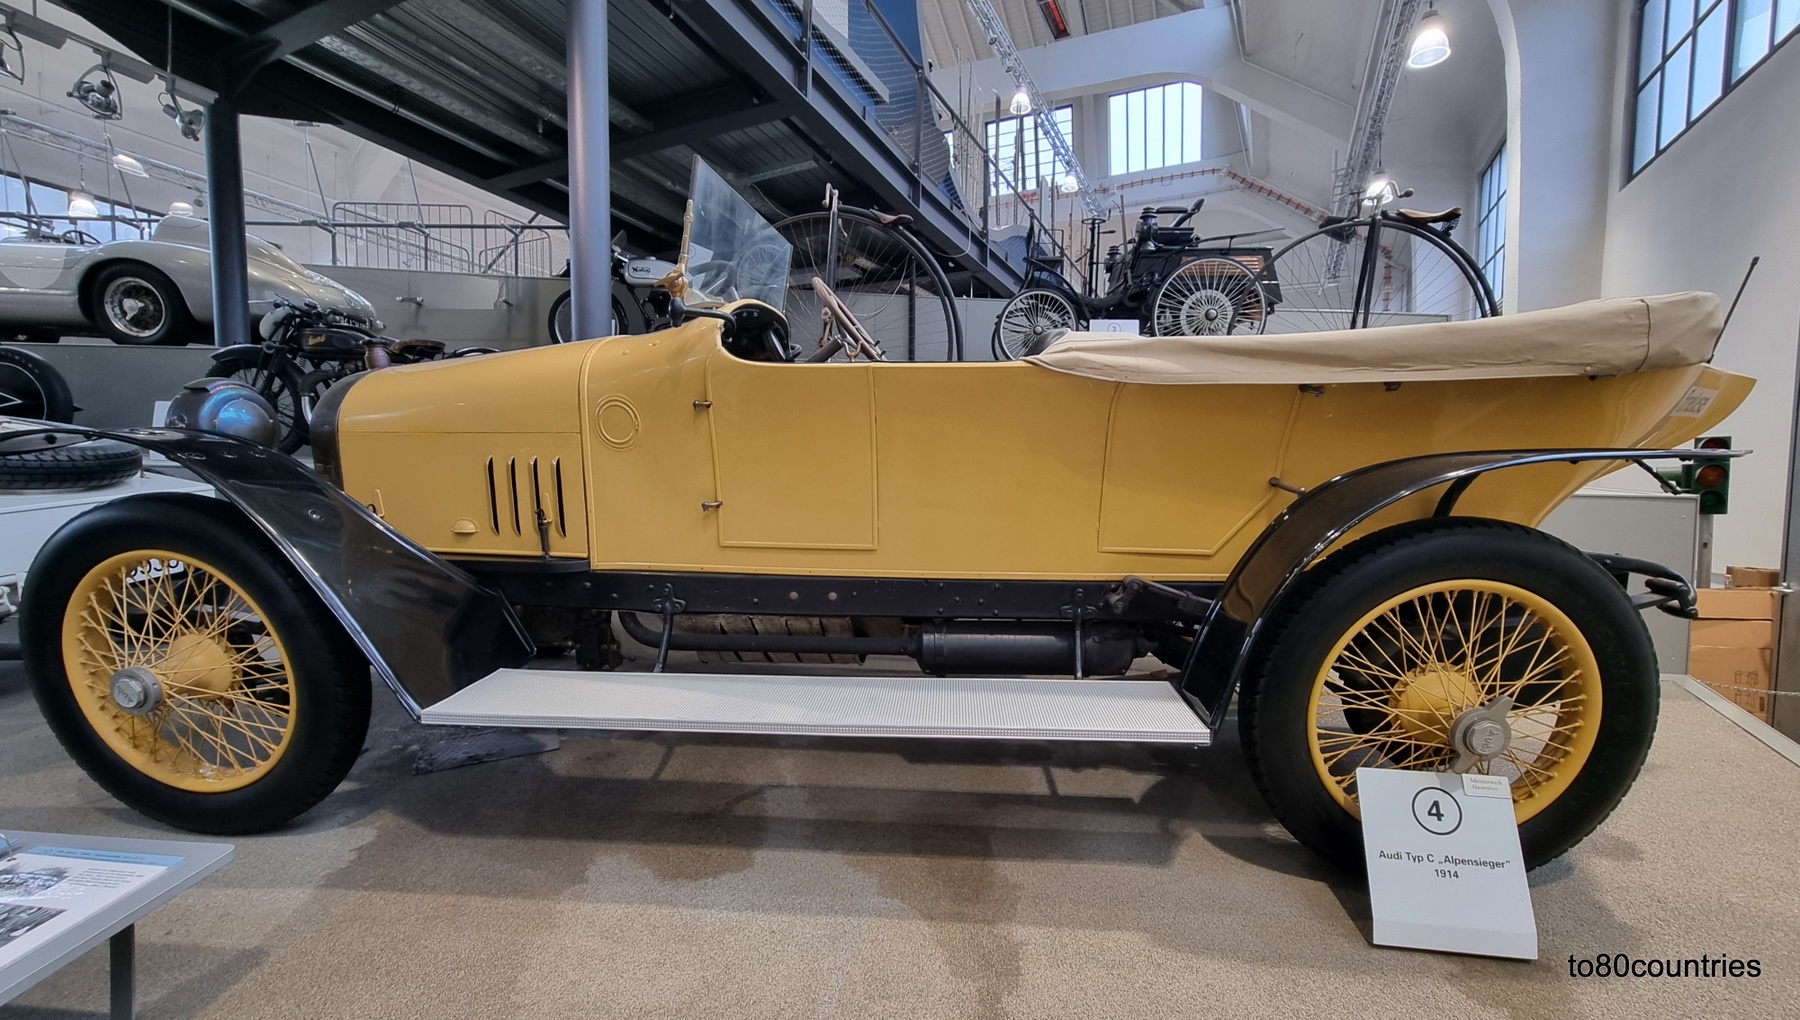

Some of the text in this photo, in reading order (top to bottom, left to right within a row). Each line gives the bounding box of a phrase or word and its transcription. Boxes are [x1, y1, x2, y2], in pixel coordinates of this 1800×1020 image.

[1480, 728, 1500, 753] Audi
[1470, 777, 1503, 786] Meisterwerk
[1427, 800, 1444, 822] 4
[1379, 850, 1511, 870] Audi Typ C „Alpensieger“
[1434, 868, 1459, 879] 1914
